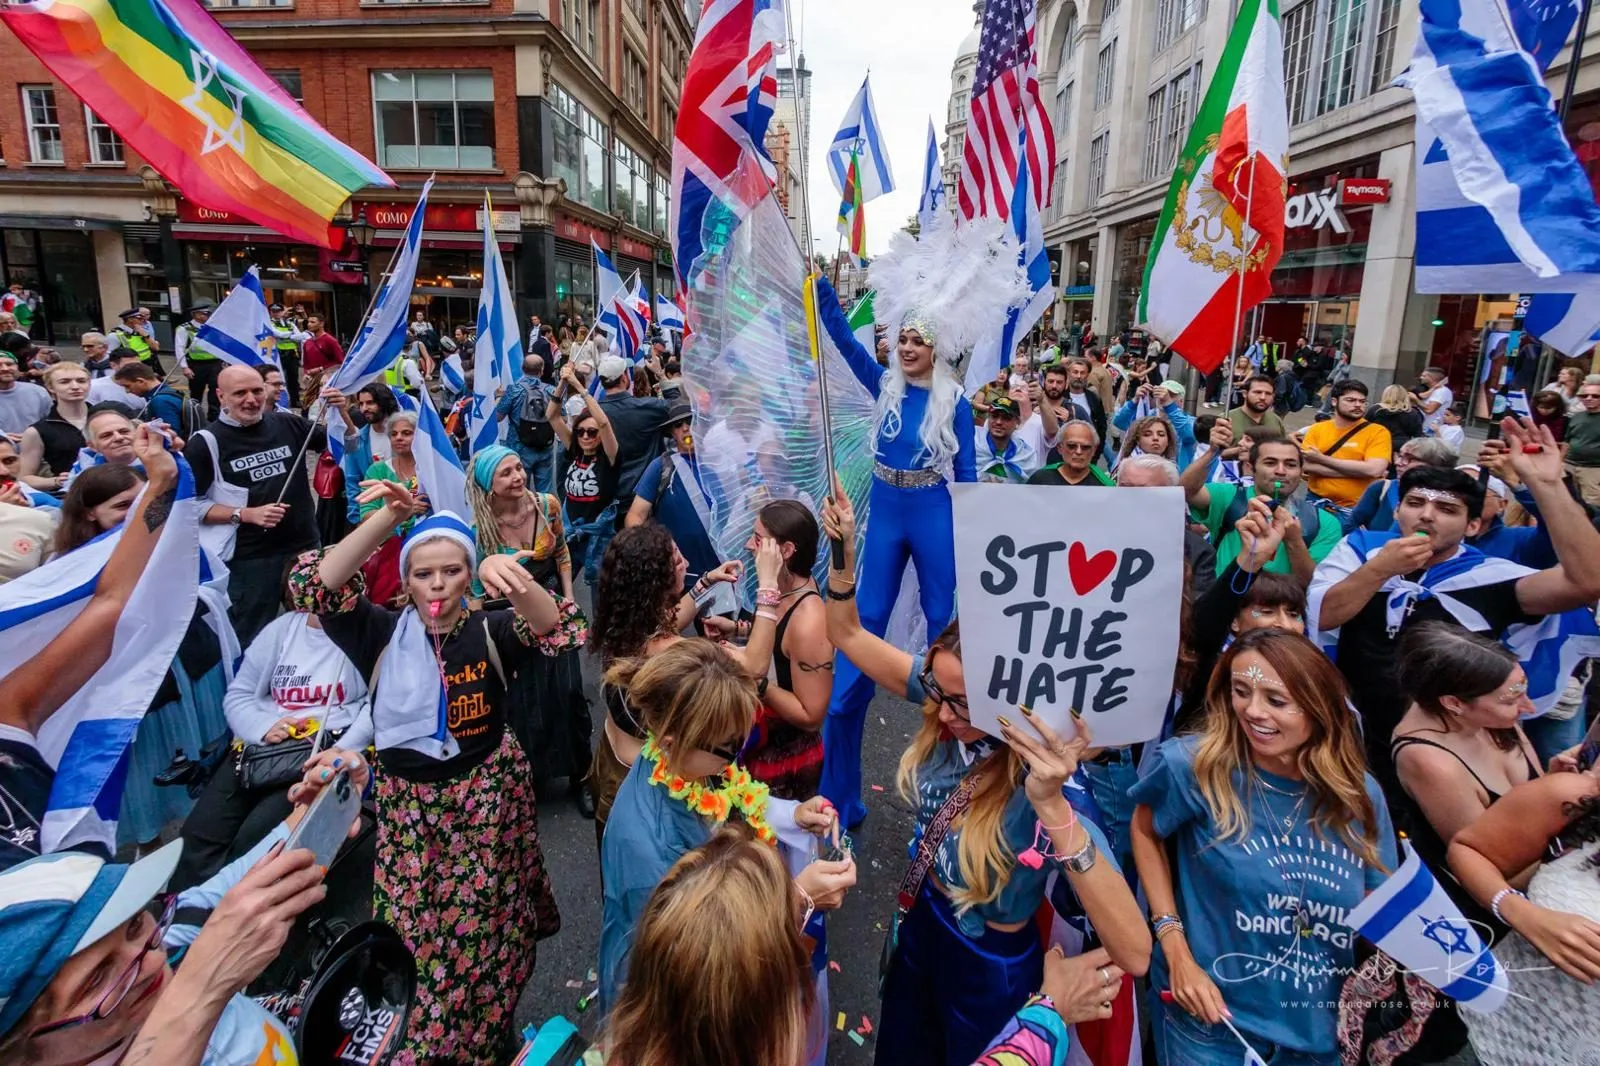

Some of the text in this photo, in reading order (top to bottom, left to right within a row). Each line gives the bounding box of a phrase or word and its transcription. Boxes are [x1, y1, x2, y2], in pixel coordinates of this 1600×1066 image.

[375, 211, 408, 224] COMO
[1284, 187, 1346, 234] axx
[234, 447, 287, 470] OPENLY
[253, 463, 281, 479] GOY
[1002, 600, 1128, 661] THE
[445, 661, 487, 684] eck?
[987, 654, 1136, 713] HATE
[1267, 893, 1350, 927] WE WIL
